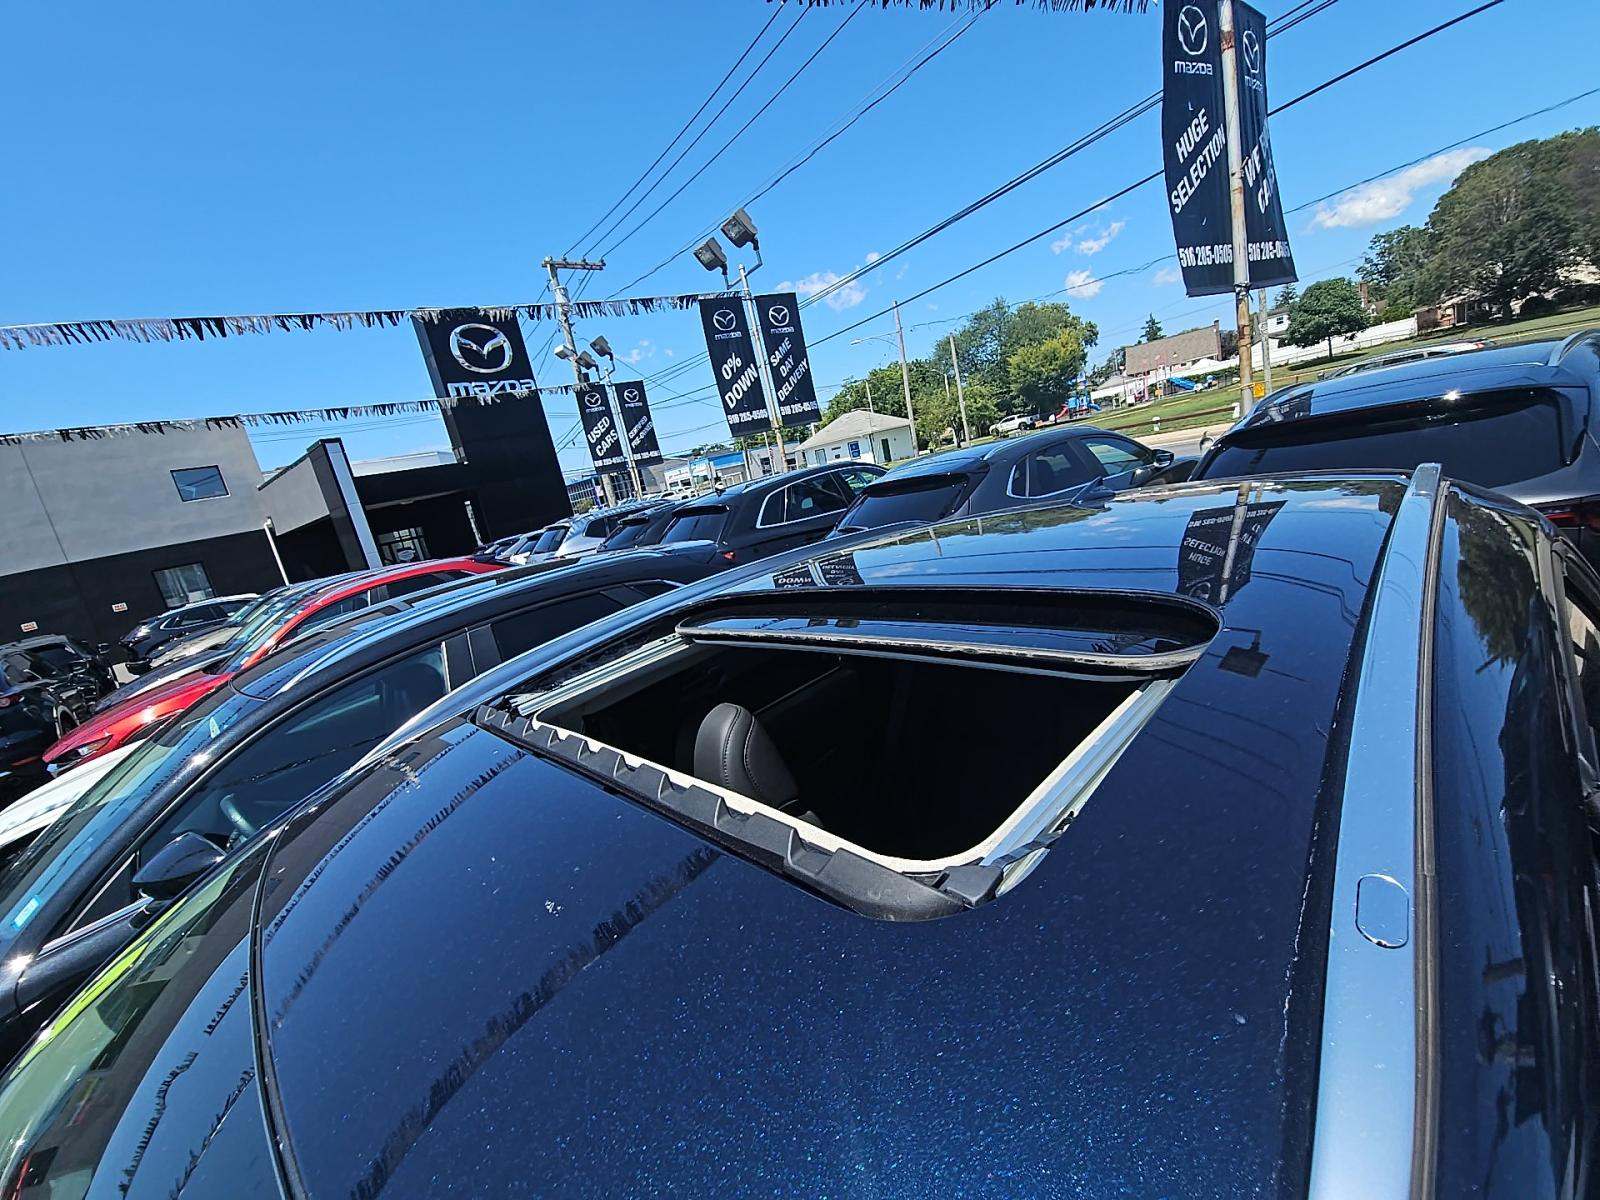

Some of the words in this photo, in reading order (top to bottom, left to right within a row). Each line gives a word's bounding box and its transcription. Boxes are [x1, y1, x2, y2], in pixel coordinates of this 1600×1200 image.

[1175, 107, 1209, 164] HUGE
[1171, 123, 1226, 214] SELECTION
[1178, 247, 1196, 268] 516
[1196, 243, 1233, 266] 285-0505
[1248, 242, 1260, 261] 516
[721, 352, 742, 380] 0%
[770, 337, 792, 367] SAME
[780, 355, 795, 377] DAY
[724, 363, 759, 410] DOWN
[777, 358, 809, 401] DELIVERY
[587, 416, 610, 444] USED
[595, 429, 619, 457] CARS
